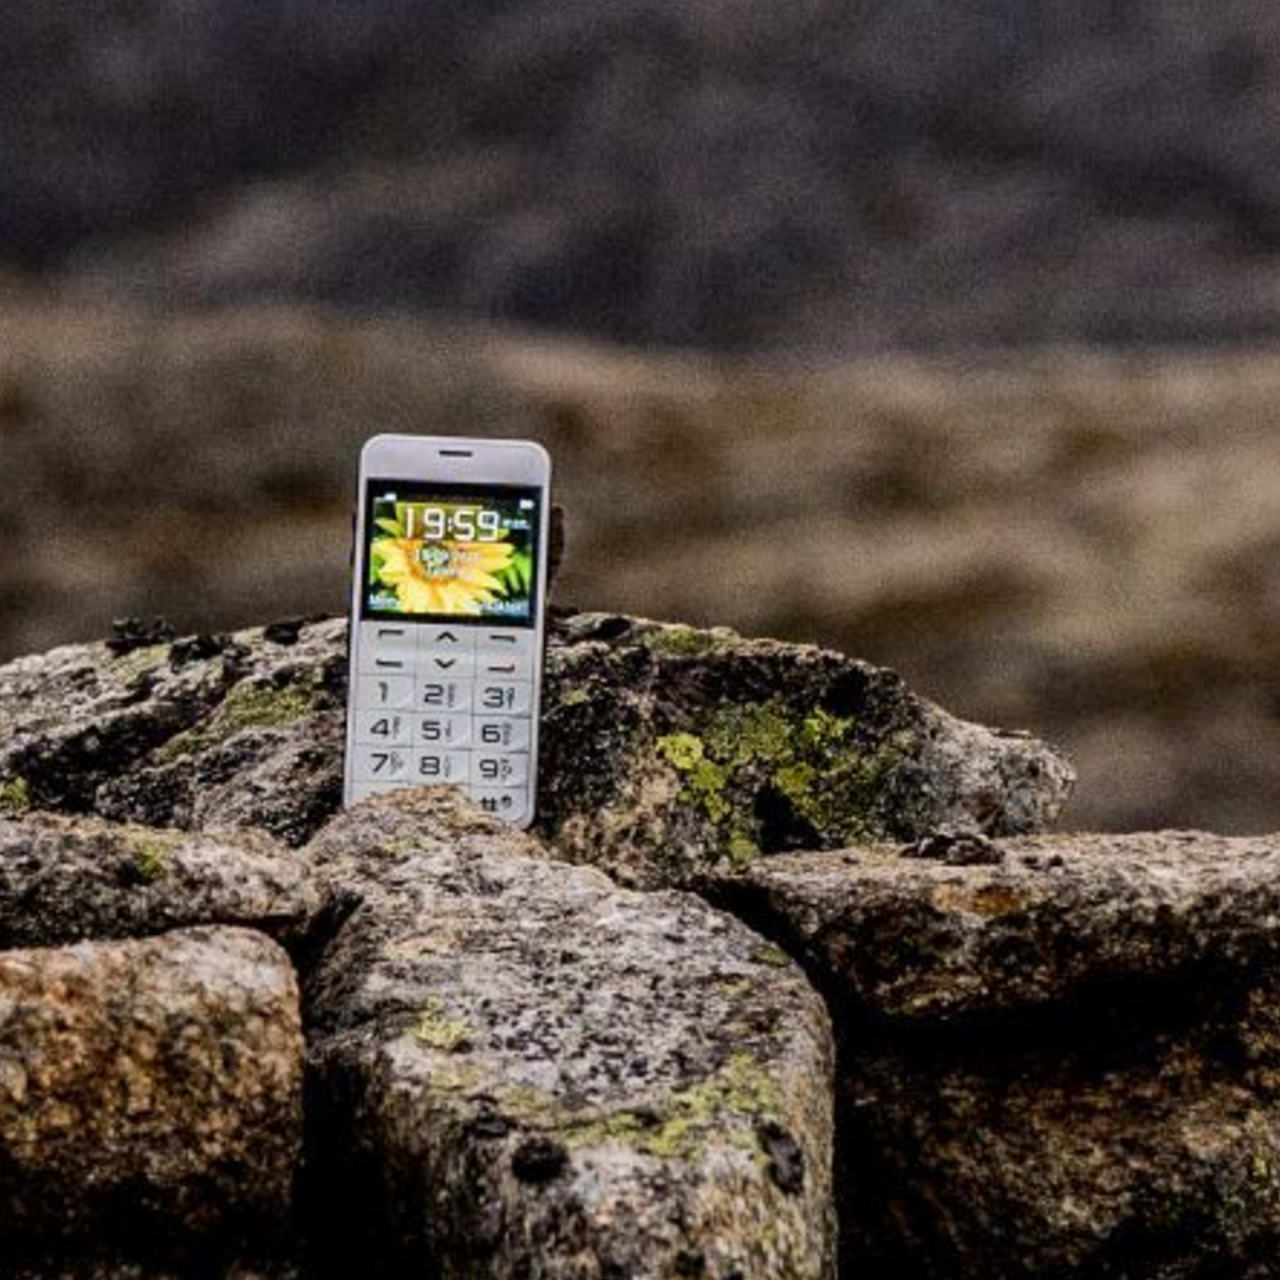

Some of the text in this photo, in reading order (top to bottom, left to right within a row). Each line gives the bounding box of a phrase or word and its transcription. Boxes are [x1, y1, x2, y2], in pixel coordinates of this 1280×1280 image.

[405, 507, 499, 541] 19:59
[379, 682, 388, 702] 1
[424, 684, 443, 705] 2
[483, 687, 504, 708] 3
[370, 719, 389, 737] 4
[422, 721, 440, 740] 5
[482, 724, 501, 743] 6
[371, 753, 388, 773] 7
[420, 756, 440, 775] 8
[479, 758, 498, 778] 9
